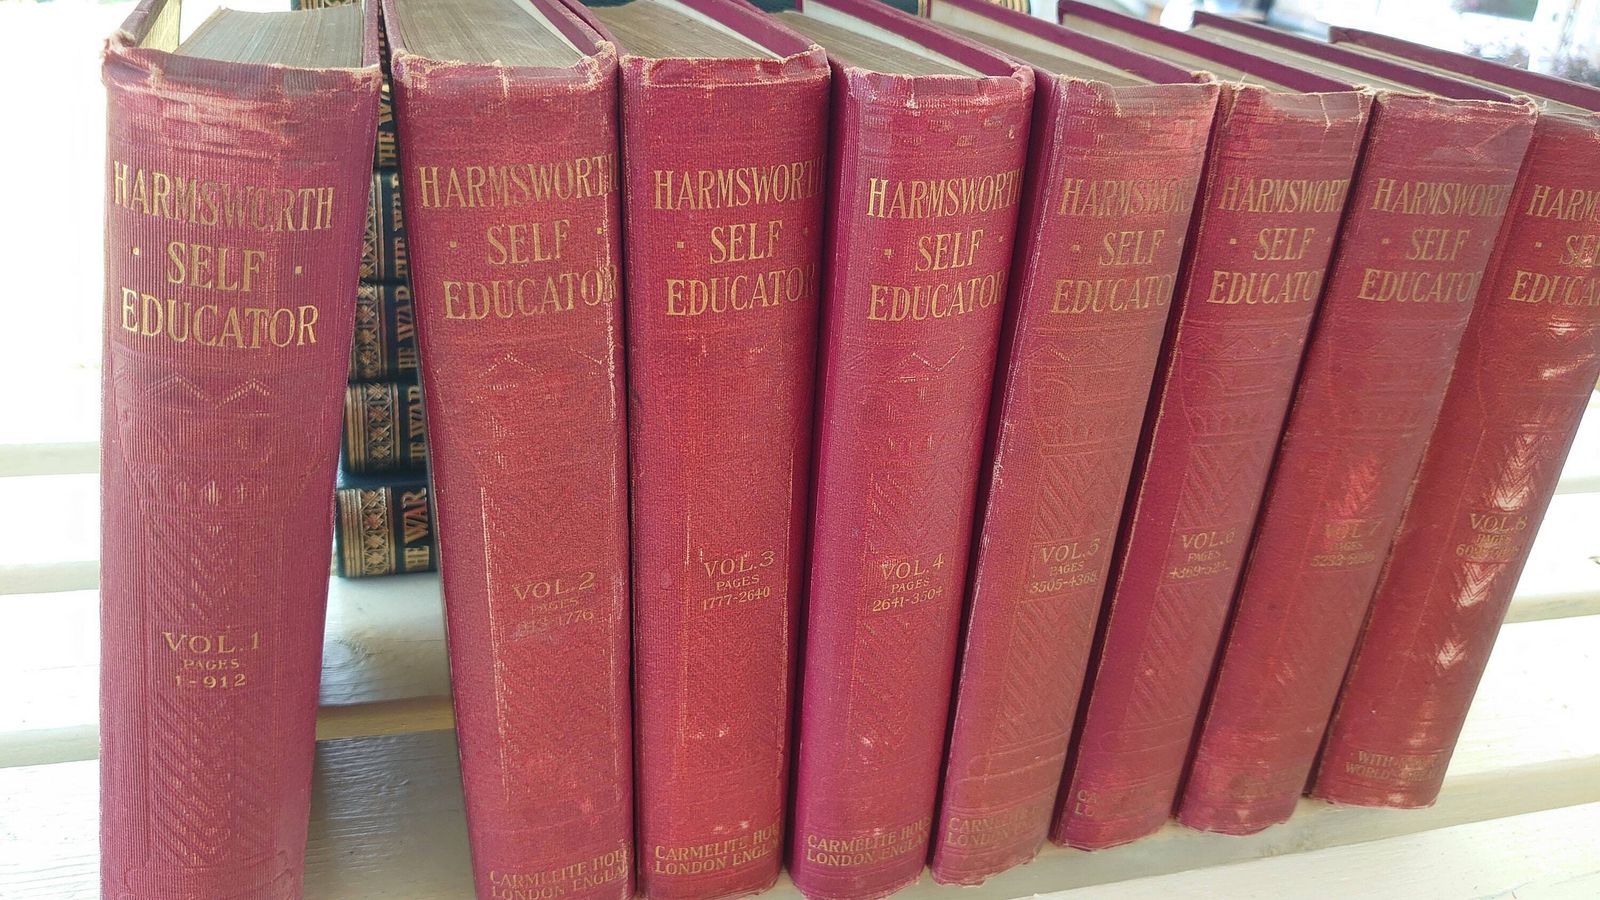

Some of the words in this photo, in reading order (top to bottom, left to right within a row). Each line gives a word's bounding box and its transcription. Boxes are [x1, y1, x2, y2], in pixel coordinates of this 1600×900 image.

[113, 160, 335, 233] HARMSWORTH
[486, 219, 571, 265] SELF
[709, 219, 783, 265] SELF
[914, 228, 984, 272] SELF
[1100, 228, 1166, 267] SELF
[1253, 227, 1316, 261] SELF
[1405, 229, 1471, 262] SELF
[166, 241, 266, 292] SELF
[121, 286, 320, 349] EDUCATOR
[401, 488, 429, 544] WAR
[1049, 561, 1085, 577] PAGES
[716, 574, 760, 591] PAGES
[891, 578, 931, 594] PAGES
[703, 585, 771, 611] 1777-2640
[872, 585, 944, 612] 2641-3504
[183, 659, 241, 671] PAGES
[175, 673, 247, 689] 1-912
[654, 836, 746, 861] CARMELITE
[808, 831, 897, 856] CARMELITE
[655, 856, 727, 875] LONDON
[807, 849, 875, 867] LONDON
[492, 884, 565, 900] LONDON
